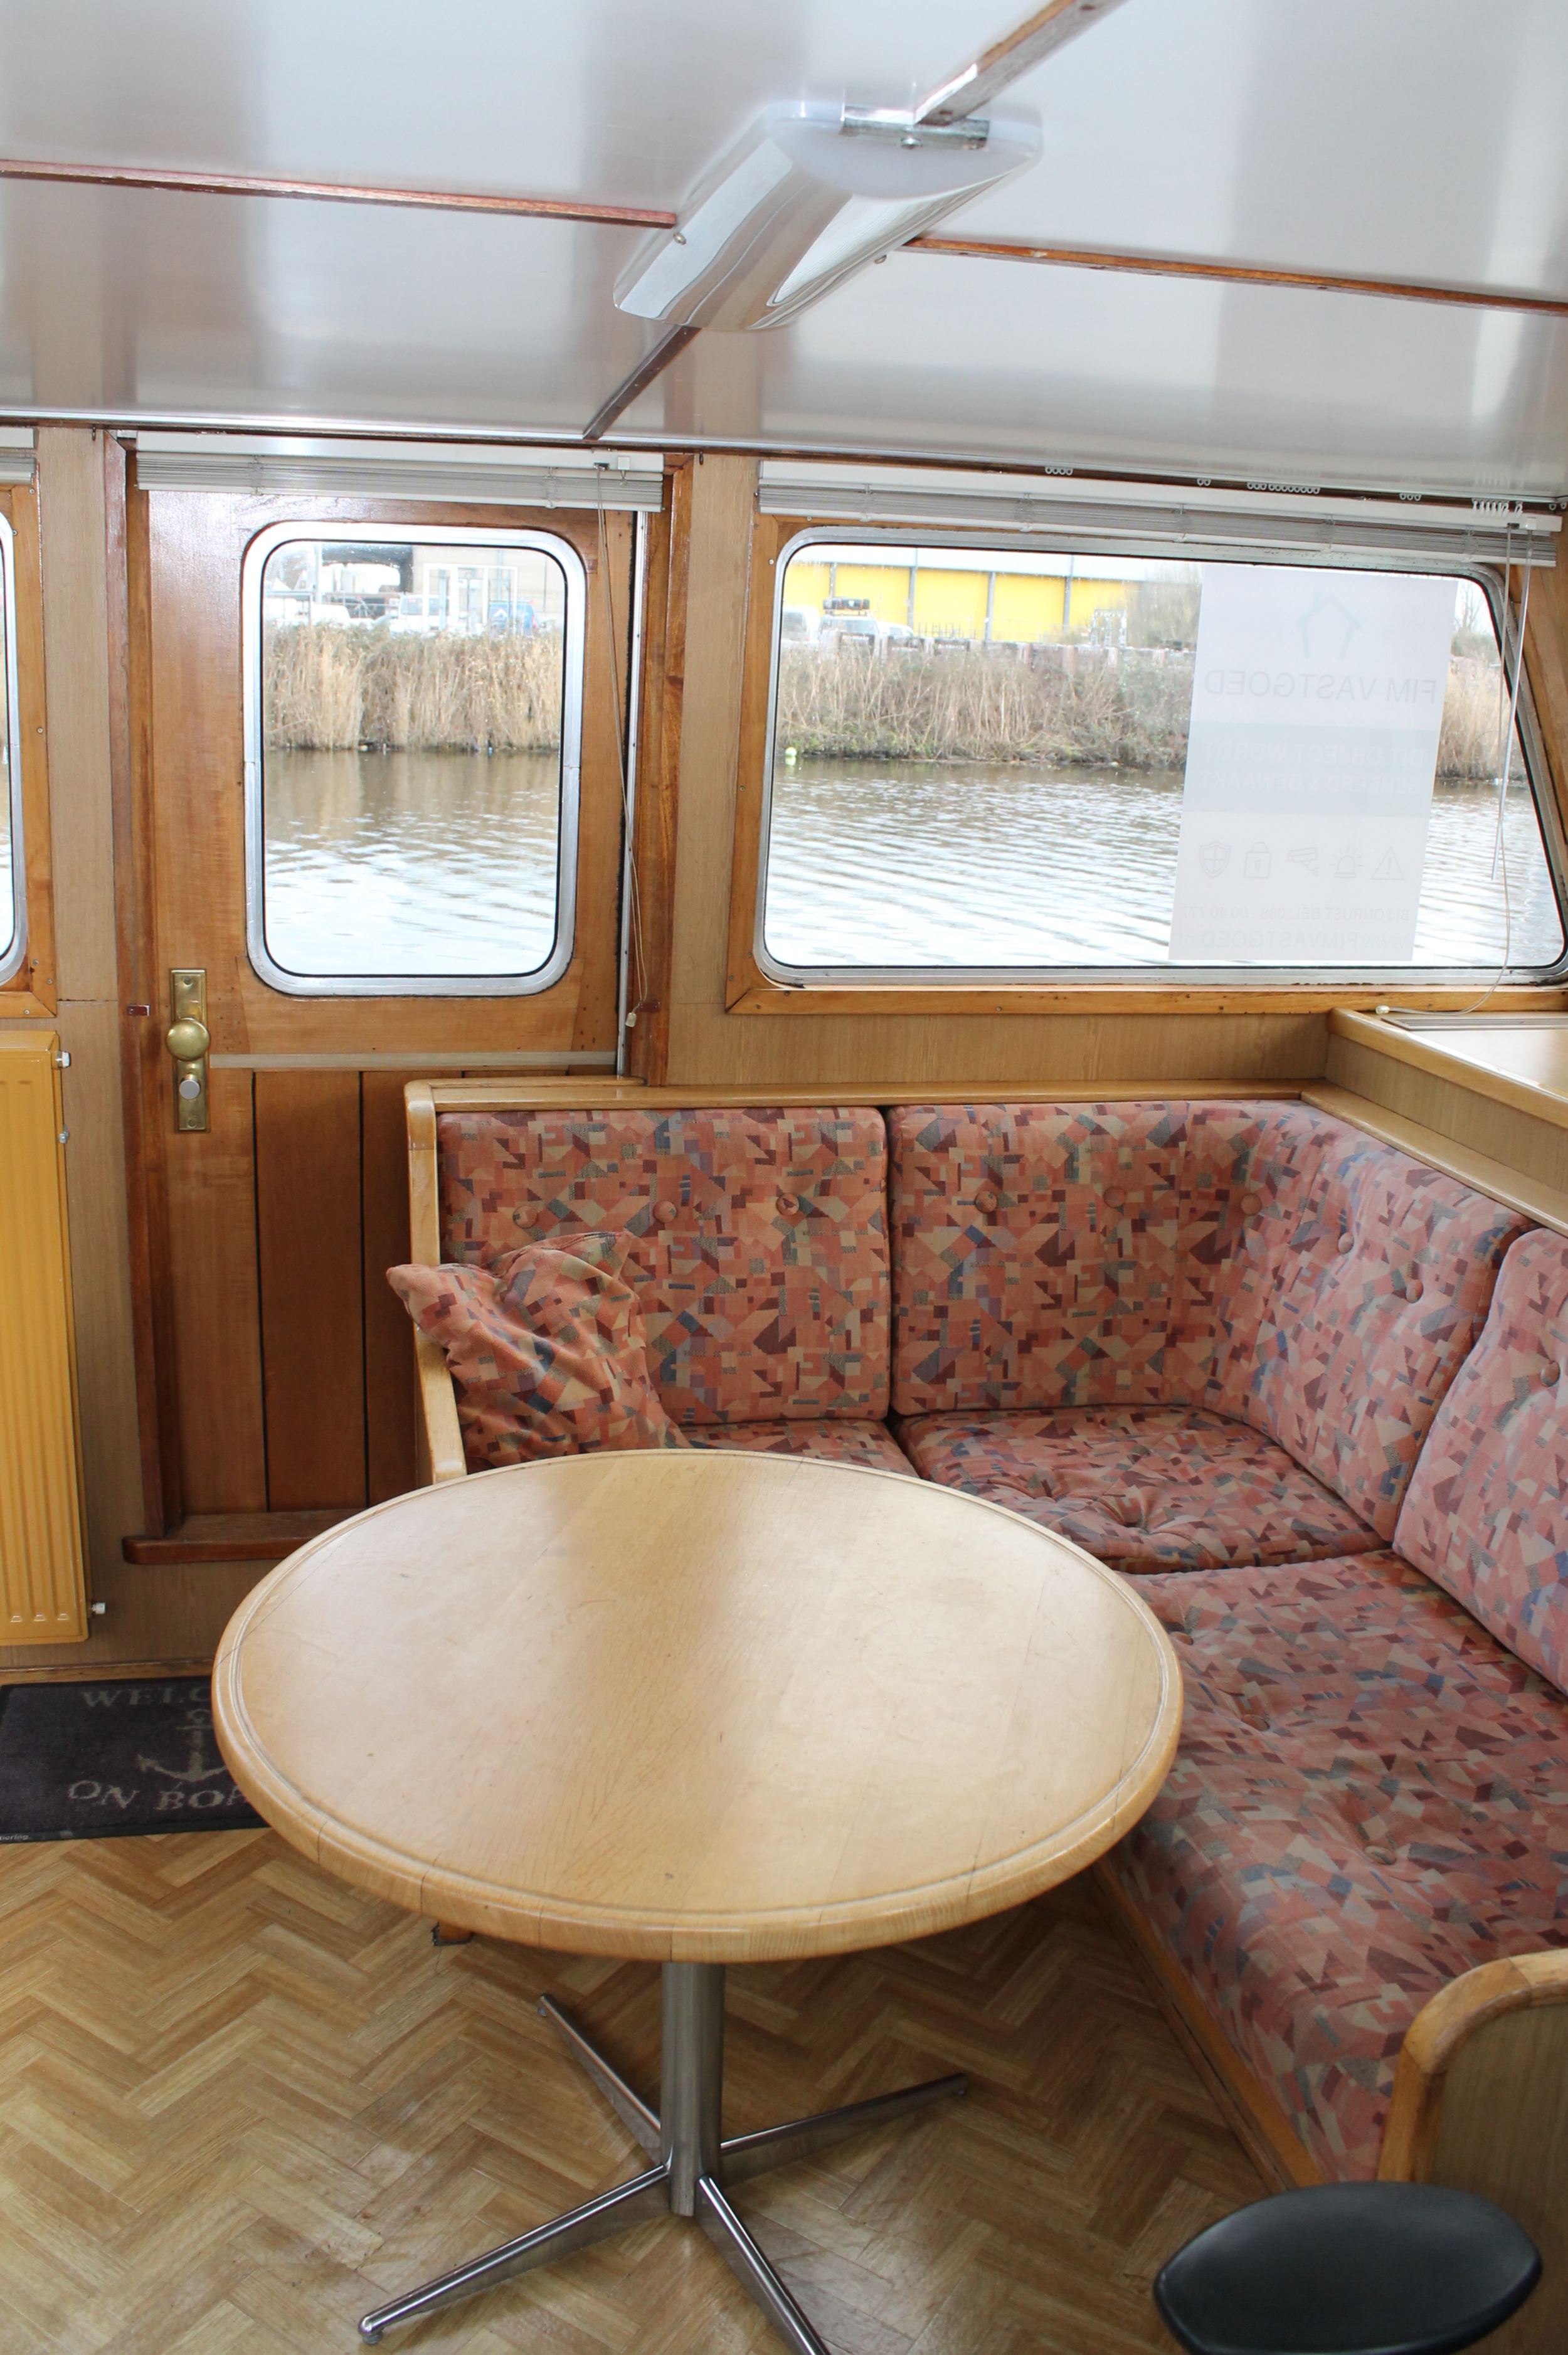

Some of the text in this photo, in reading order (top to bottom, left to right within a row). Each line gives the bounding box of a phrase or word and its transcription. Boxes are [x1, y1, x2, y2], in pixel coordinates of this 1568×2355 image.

[80, 1686, 212, 1707] WELC
[68, 1780, 250, 1810] ON BOA
